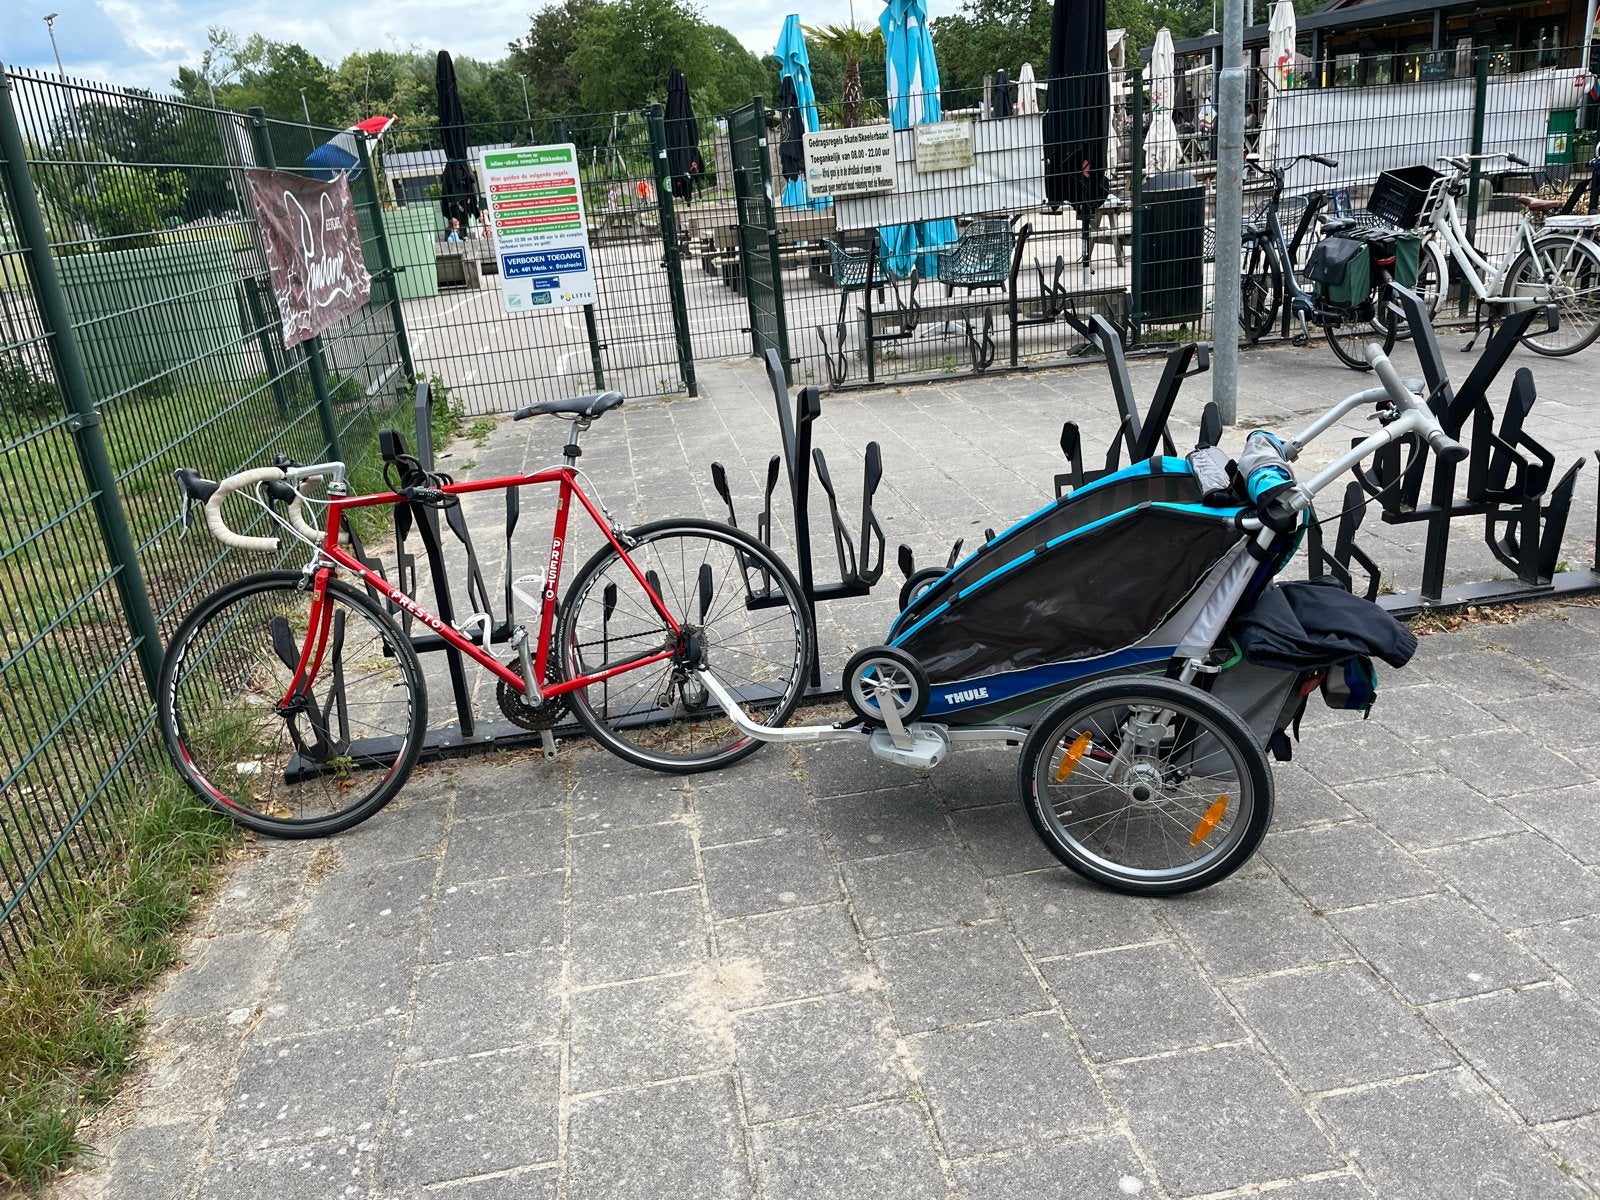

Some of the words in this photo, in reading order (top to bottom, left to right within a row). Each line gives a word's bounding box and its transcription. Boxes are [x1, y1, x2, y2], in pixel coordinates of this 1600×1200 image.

[808, 135, 843, 150] Gedragsregels
[810, 152, 841, 166] Toegankelijk
[851, 149, 864, 159] 08.00
[868, 148, 881, 157] 22.00
[882, 148, 890, 156] uur
[507, 255, 545, 266] VERBODEN
[547, 251, 581, 262] TOEGANG
[555, 261, 582, 270] Strafrecht
[560, 289, 591, 302] POLITIE
[547, 541, 560, 599] PRESTO
[391, 591, 440, 628] PRESTO
[944, 687, 989, 704] THULE
